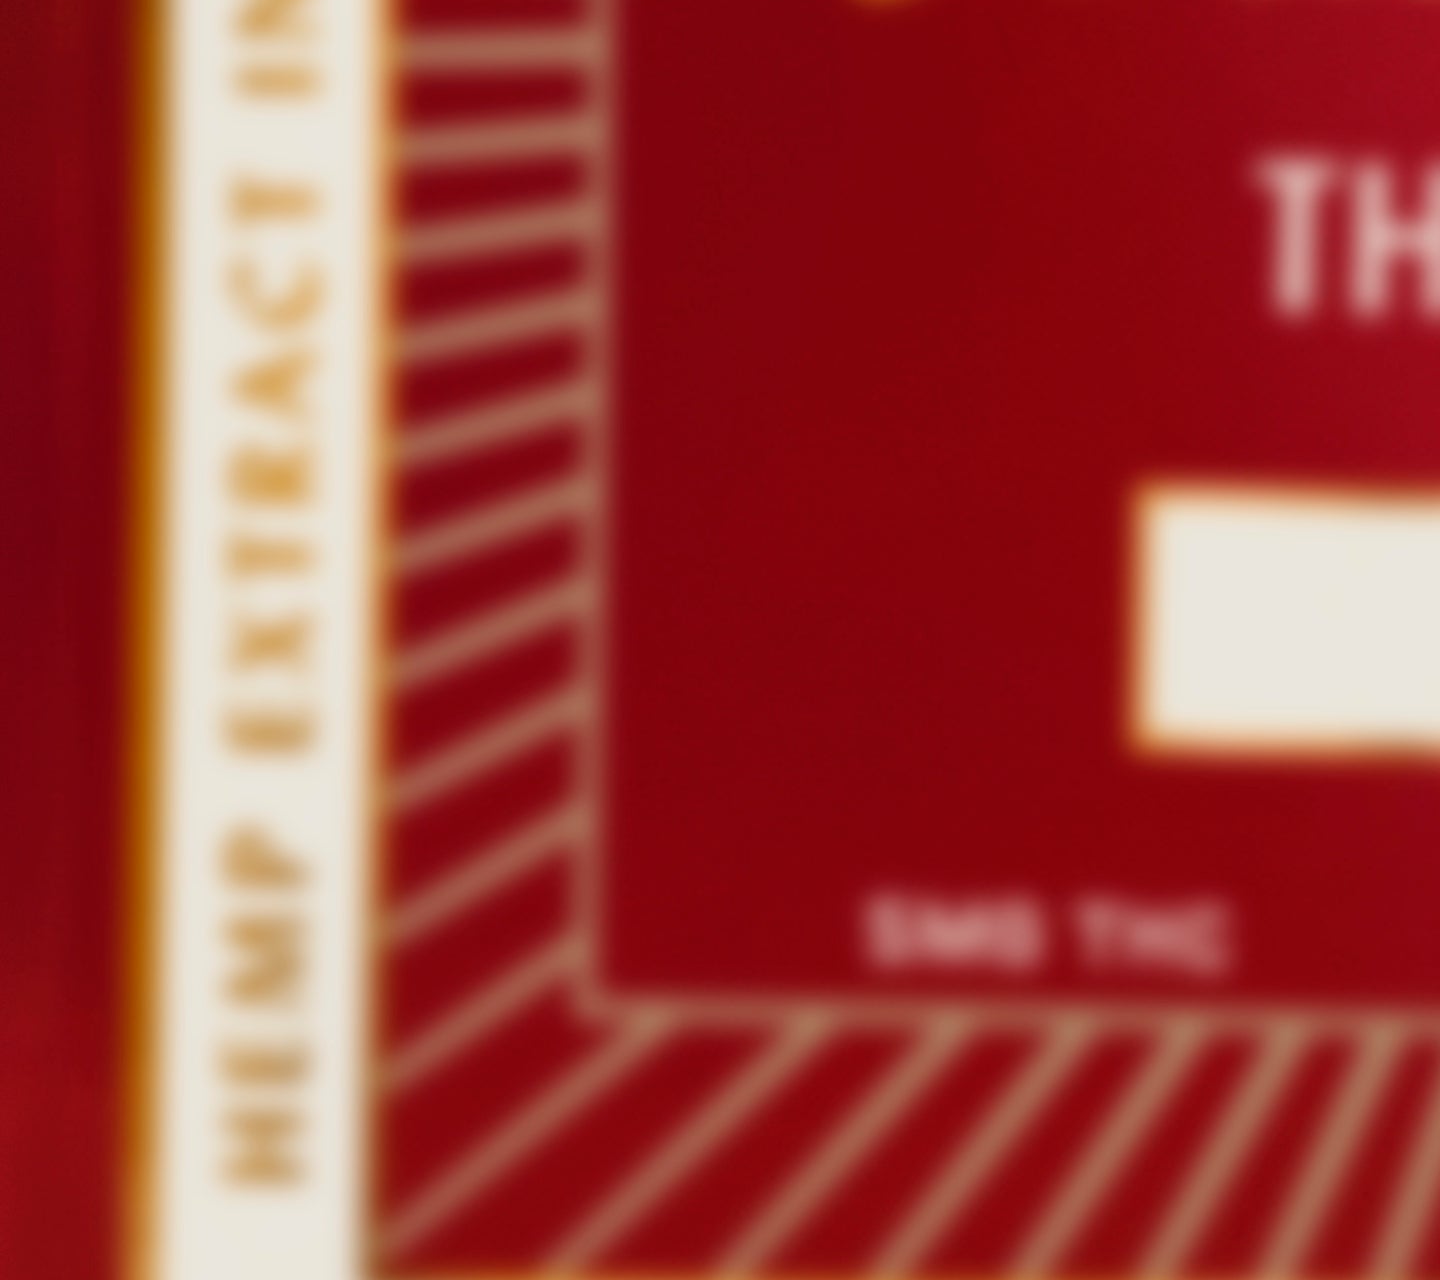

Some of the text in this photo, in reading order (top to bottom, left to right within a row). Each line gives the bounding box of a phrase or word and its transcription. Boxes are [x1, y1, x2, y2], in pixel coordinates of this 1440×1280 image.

[220, 175, 322, 756] EXTRACT
[218, 824, 314, 1190] HEMP
[1074, 900, 1232, 976] THC
